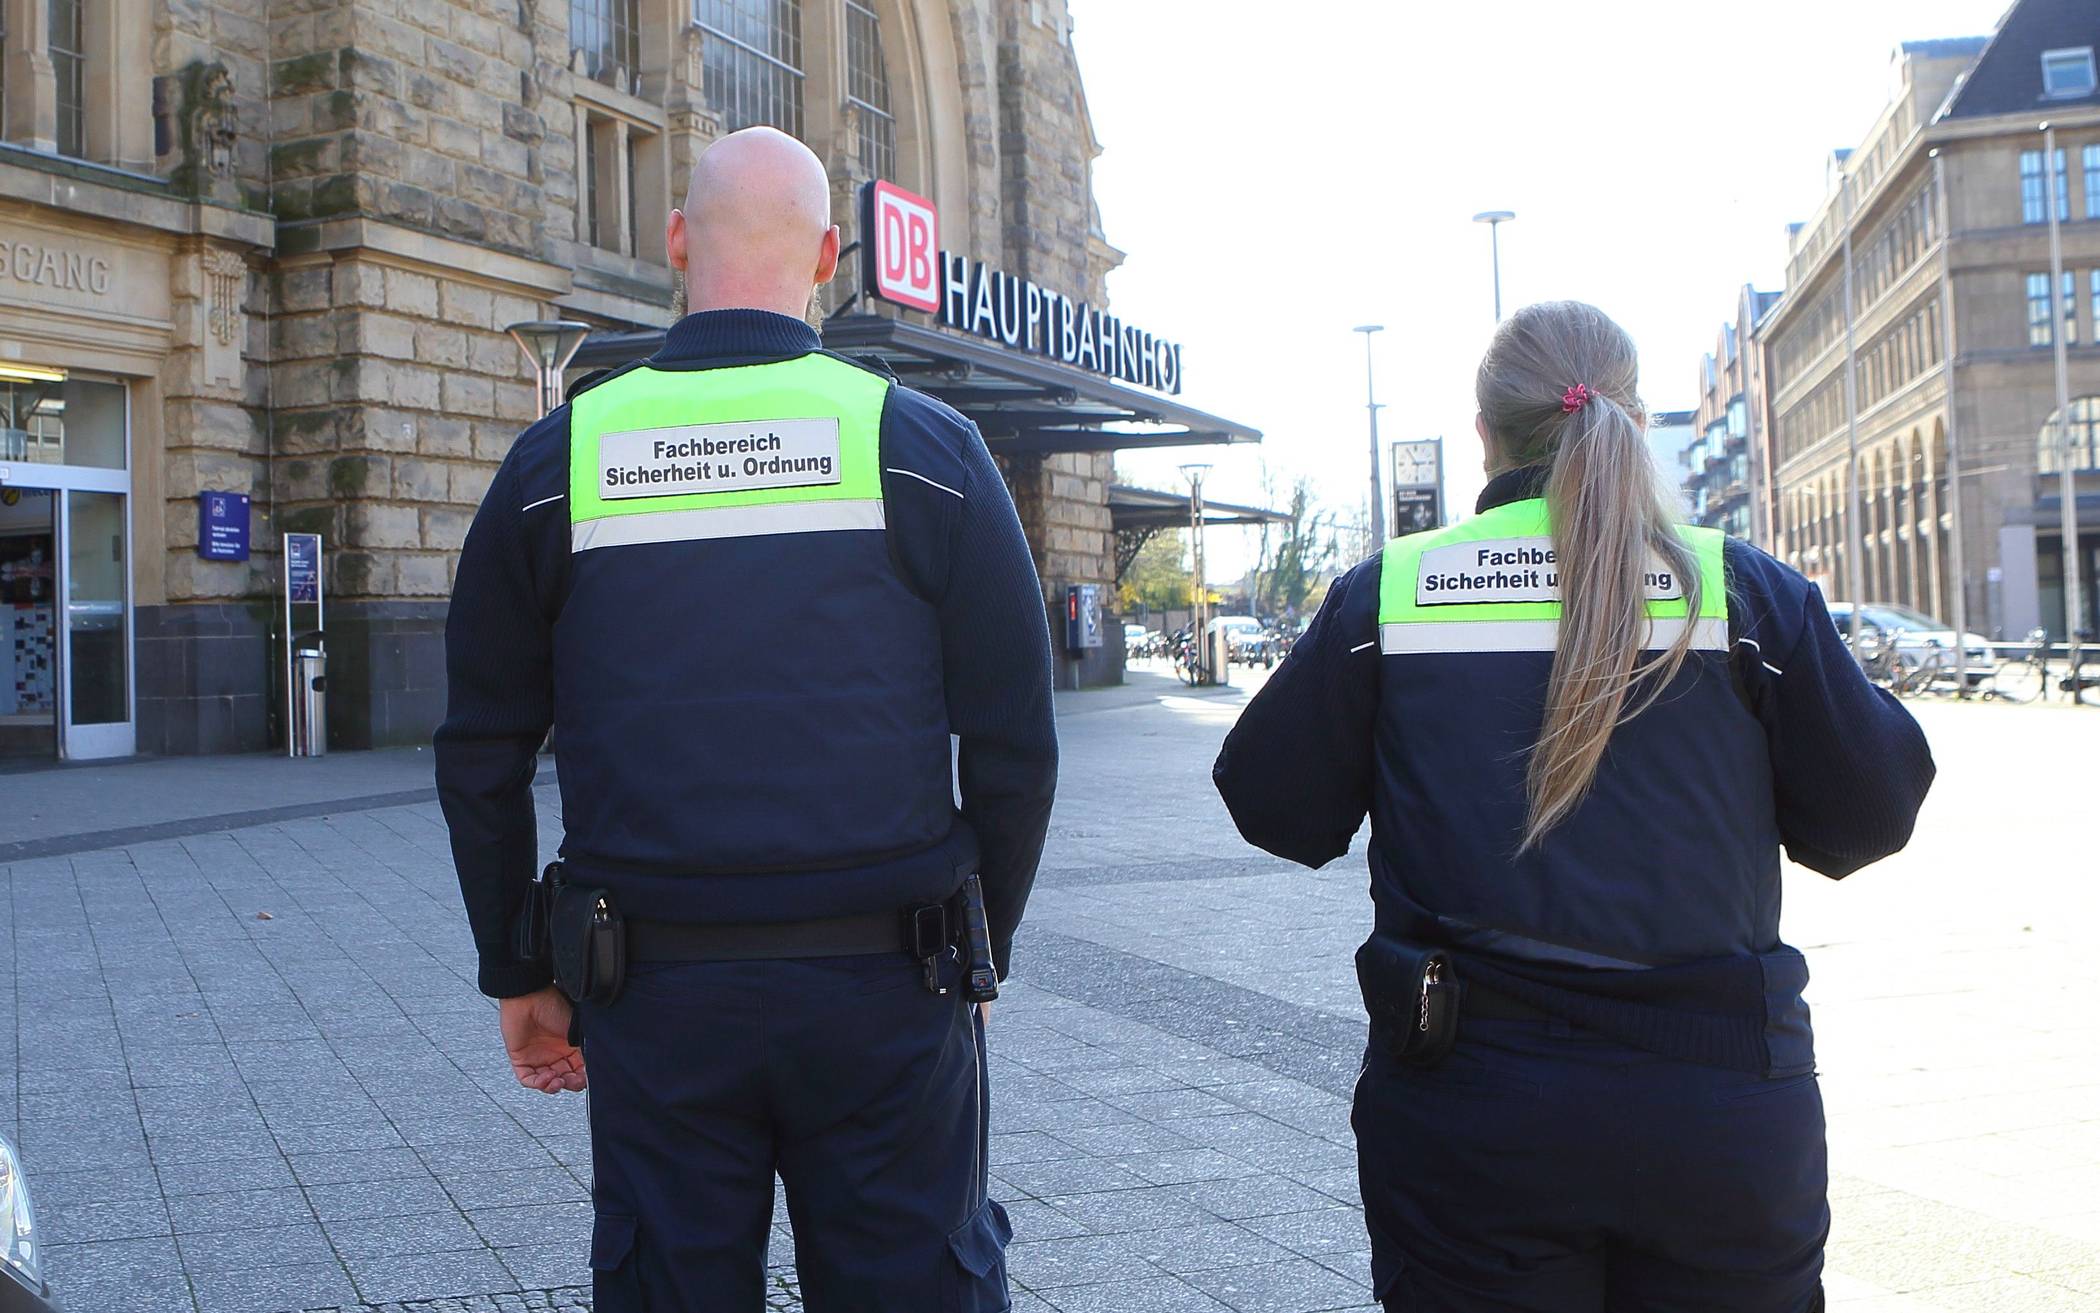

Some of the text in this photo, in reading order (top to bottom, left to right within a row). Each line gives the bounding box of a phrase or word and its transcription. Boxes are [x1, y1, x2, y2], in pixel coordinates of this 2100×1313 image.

[884, 202, 931, 290] DB
[653, 433, 781, 459] Fachbereich
[606, 455, 832, 486] Sicherheit u. Ordnung
[1477, 547, 1557, 567] Fachbe
[1424, 570, 1539, 591] Sicherheit
